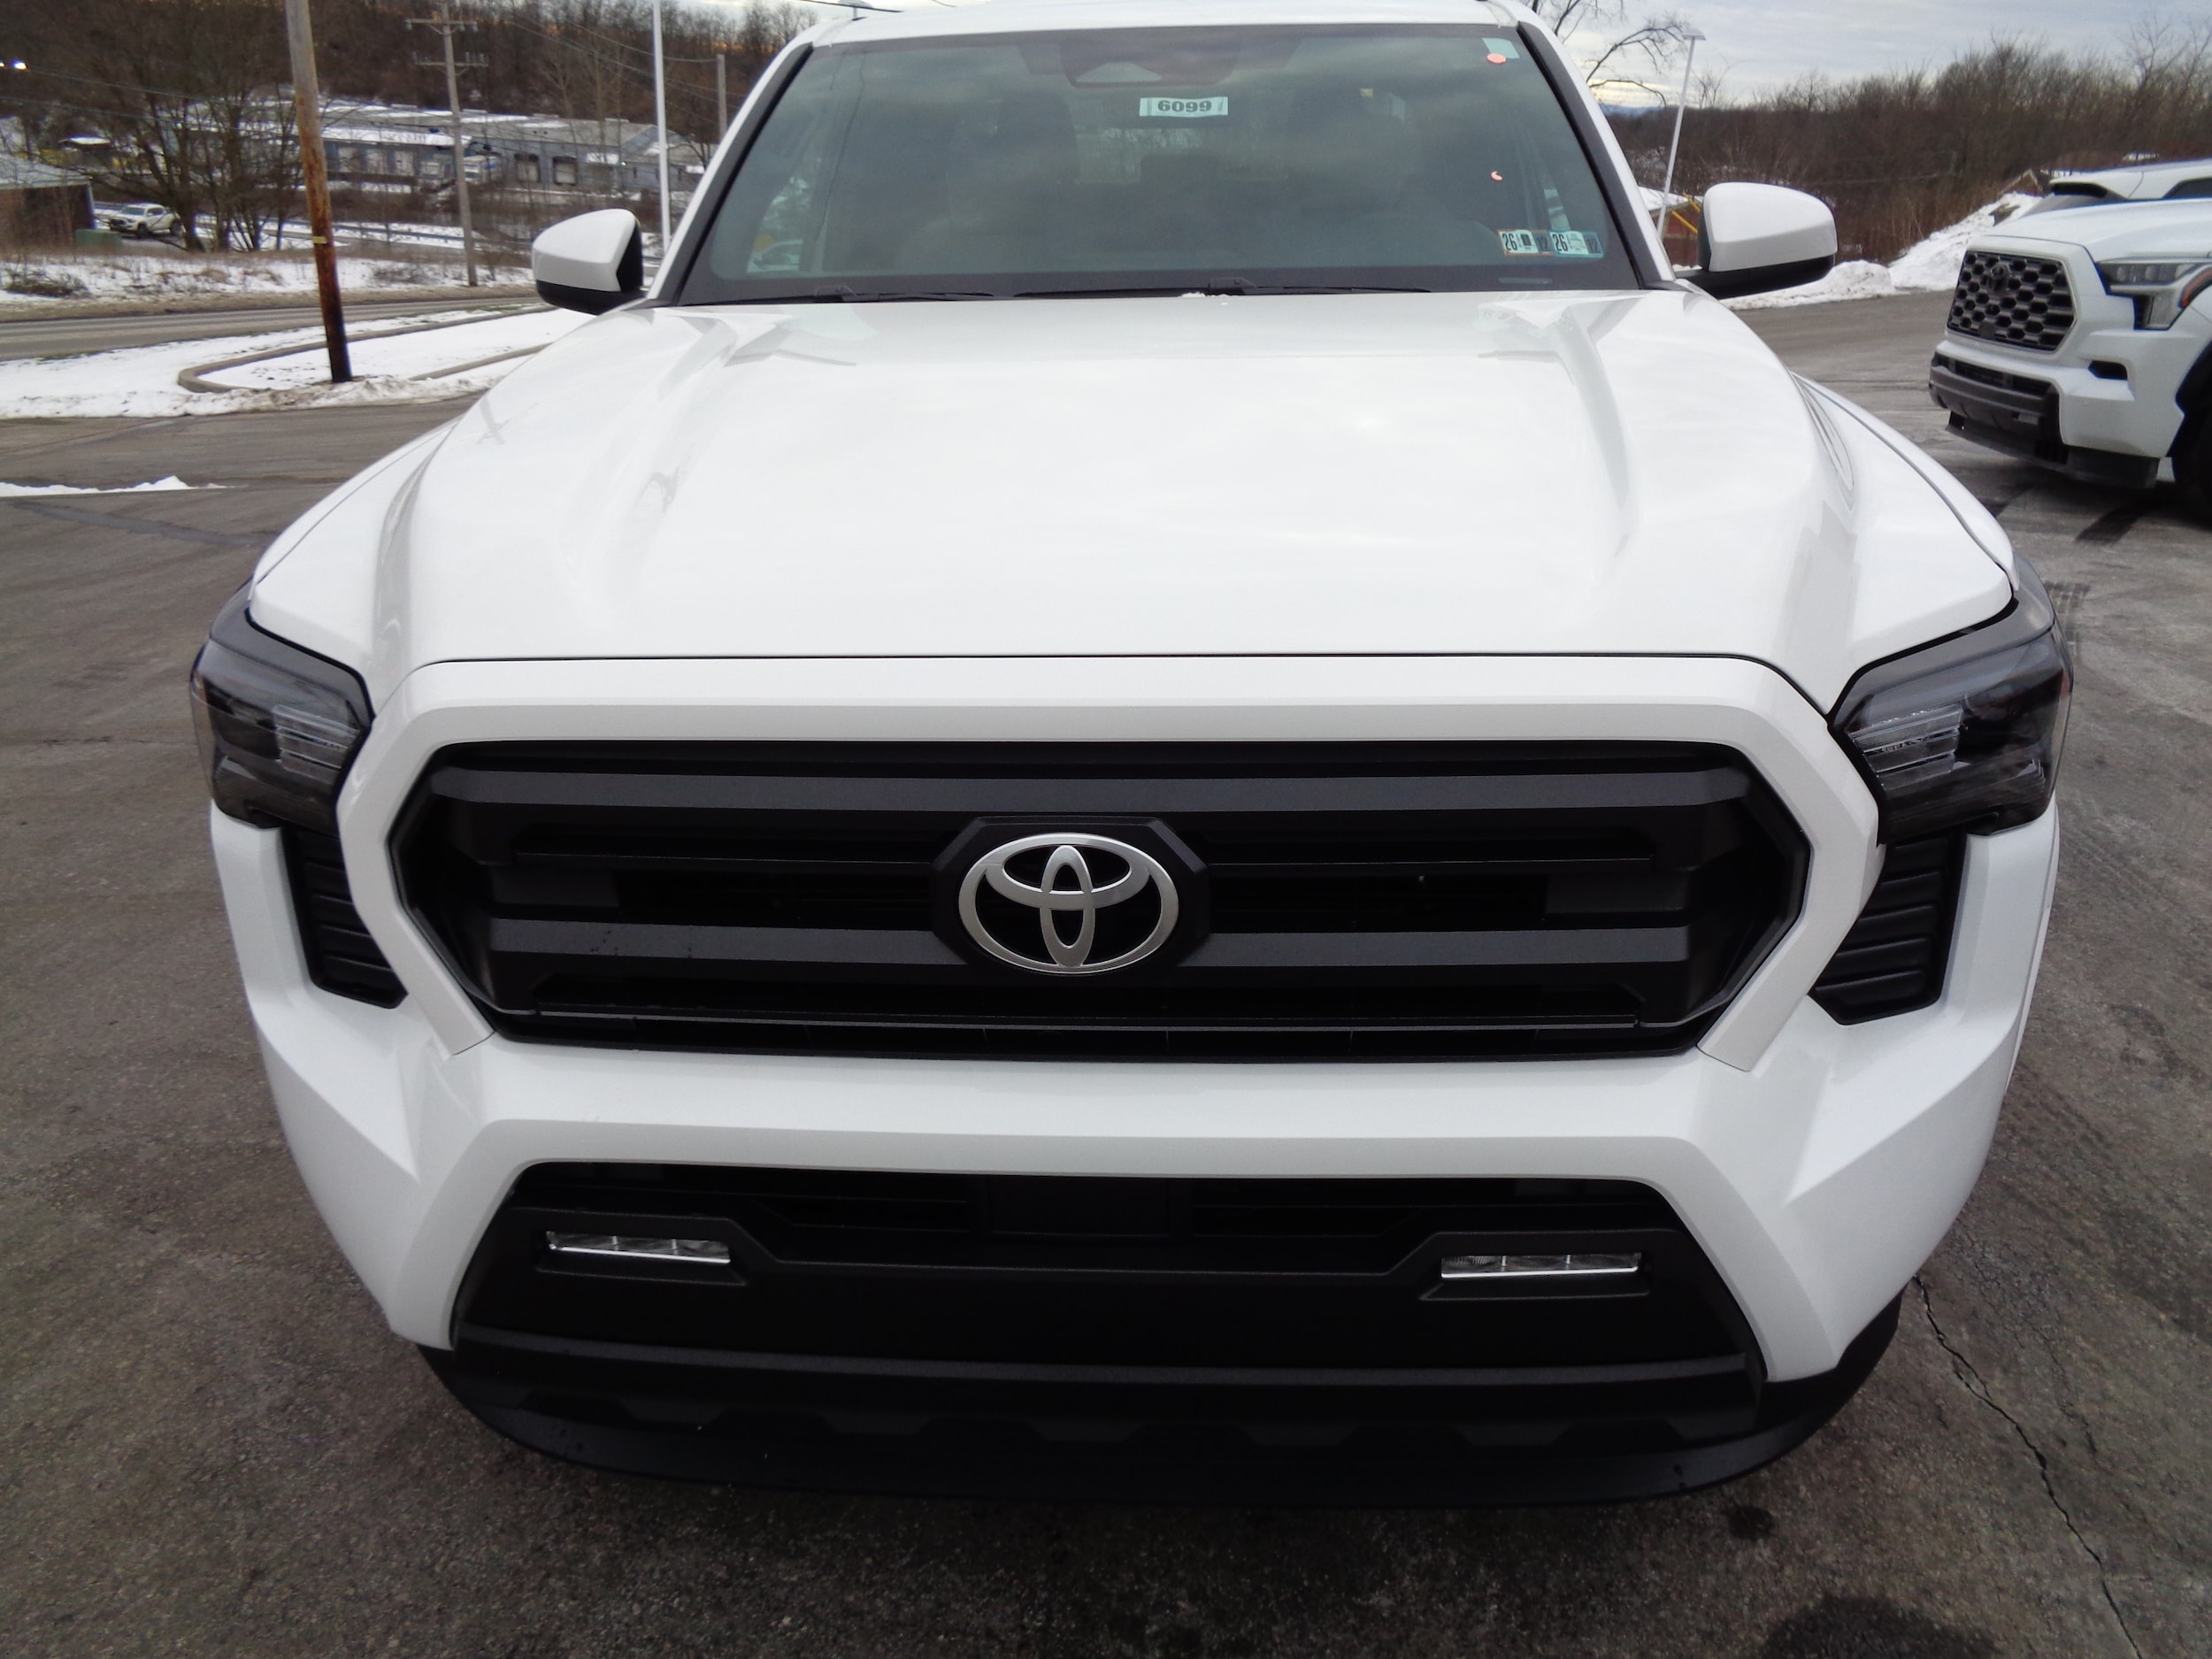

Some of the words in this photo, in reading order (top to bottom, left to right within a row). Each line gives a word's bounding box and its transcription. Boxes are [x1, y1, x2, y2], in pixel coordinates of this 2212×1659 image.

[1157, 99, 1212, 112] 6099
[1502, 233, 1517, 250] 26
[1552, 233, 1568, 251] 26
